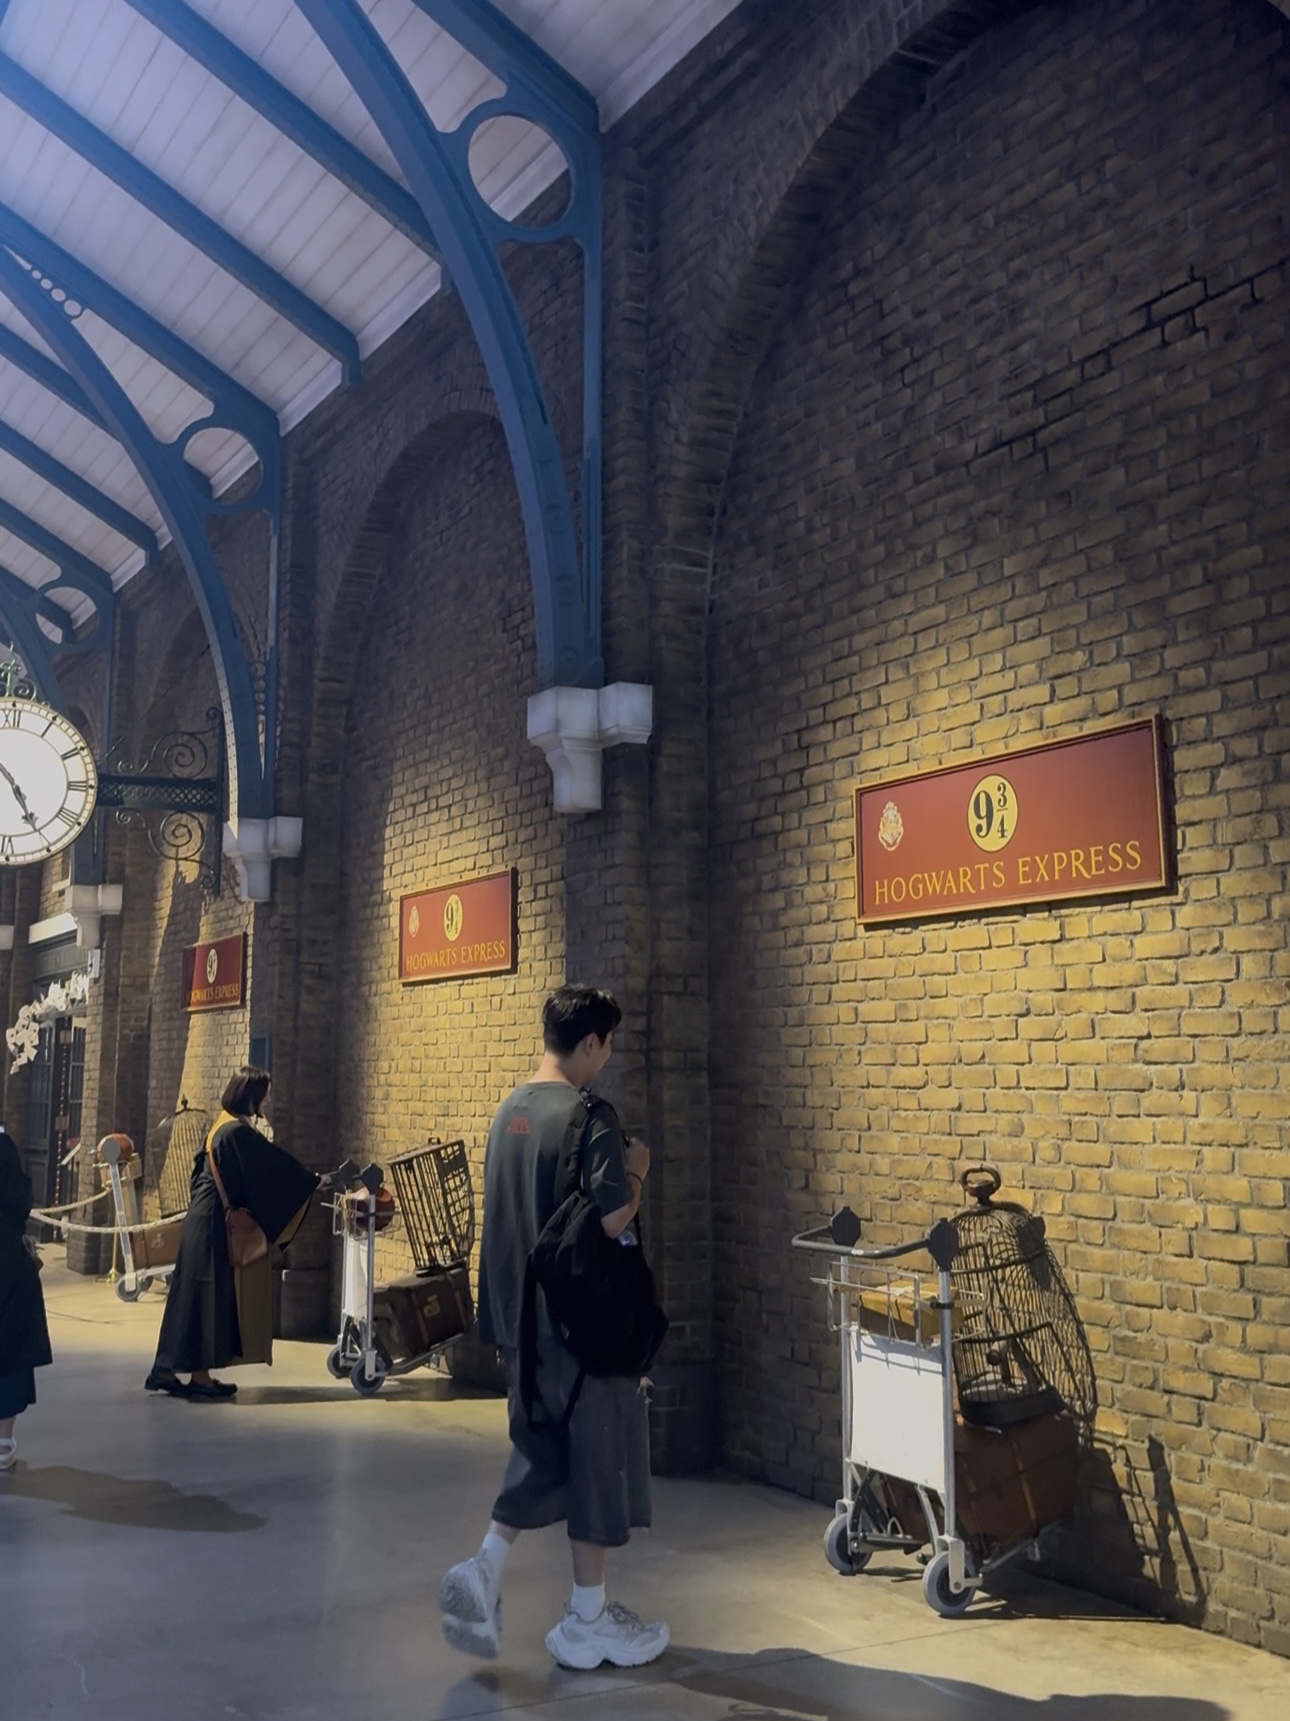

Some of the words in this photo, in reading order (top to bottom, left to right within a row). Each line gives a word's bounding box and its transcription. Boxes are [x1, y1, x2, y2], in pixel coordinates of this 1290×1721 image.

[874, 860, 1005, 905] HOGWARTS
[1017, 840, 1142, 886] EXPRESS
[406, 947, 457, 971] HOGWARTS
[461, 940, 506, 964] EXPRESS
